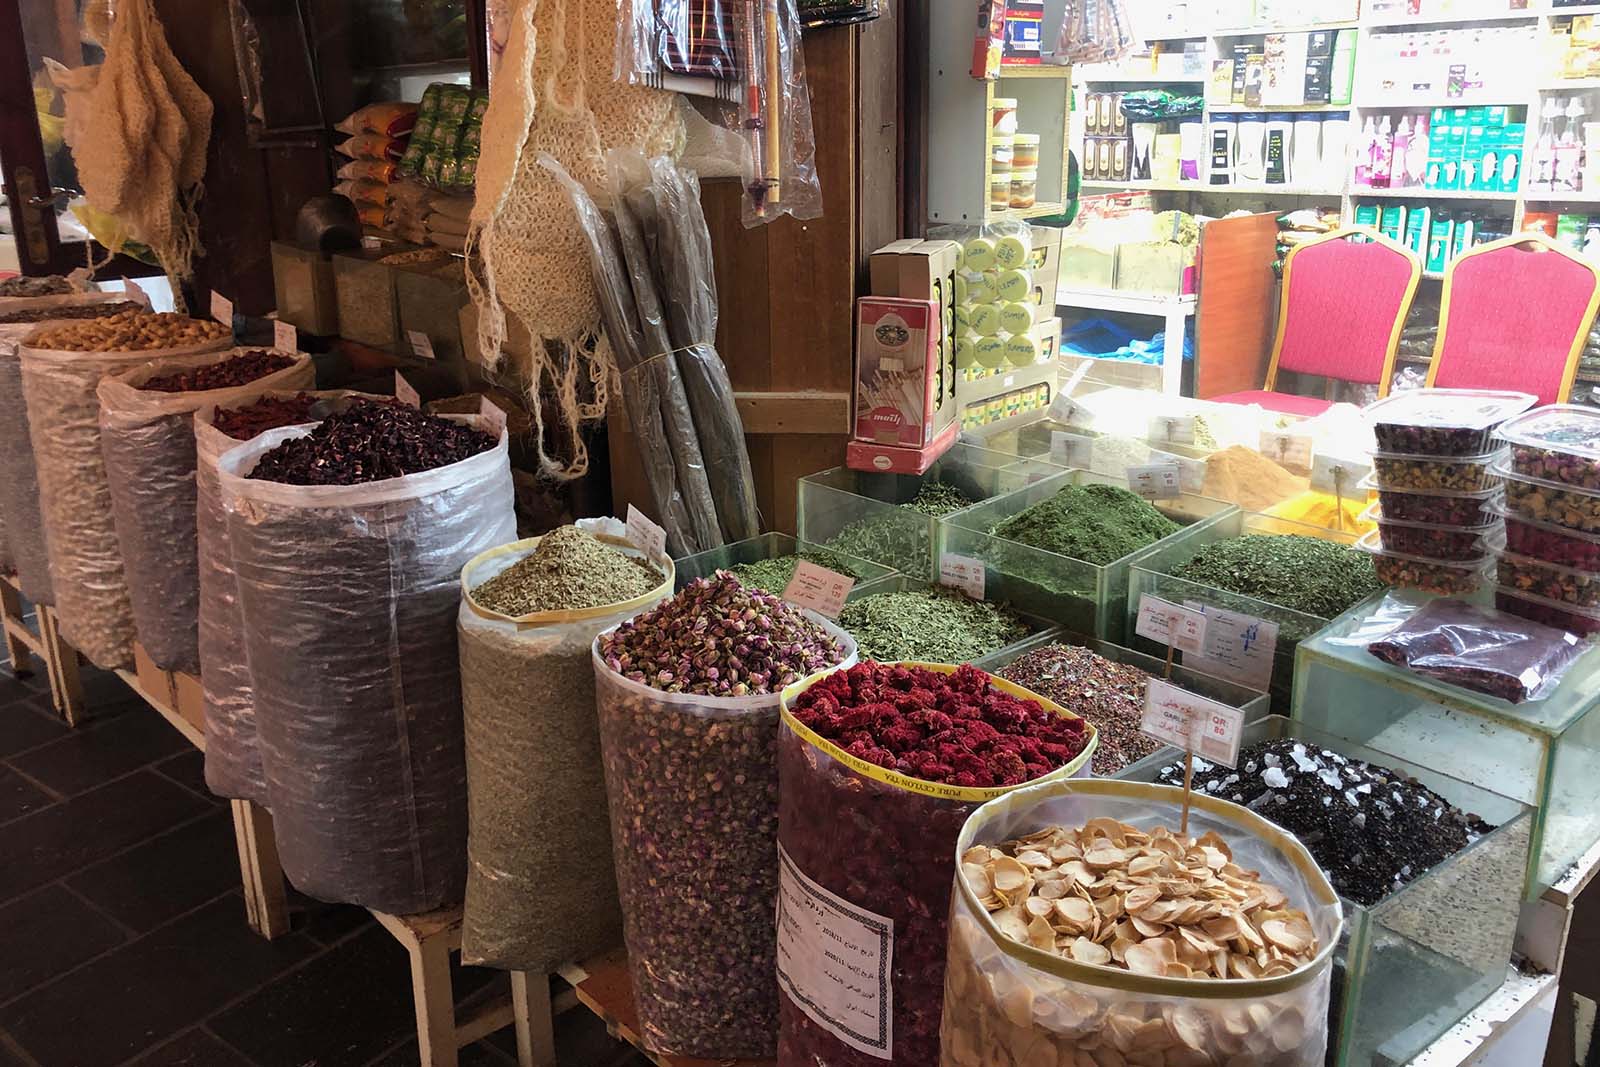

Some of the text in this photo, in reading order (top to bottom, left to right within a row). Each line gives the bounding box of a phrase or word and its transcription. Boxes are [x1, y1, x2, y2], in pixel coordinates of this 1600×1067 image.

[1213, 715, 1229, 729] QR:
[853, 760, 870, 773] PURE
[884, 773, 961, 798] PURE CEYLON TEA
